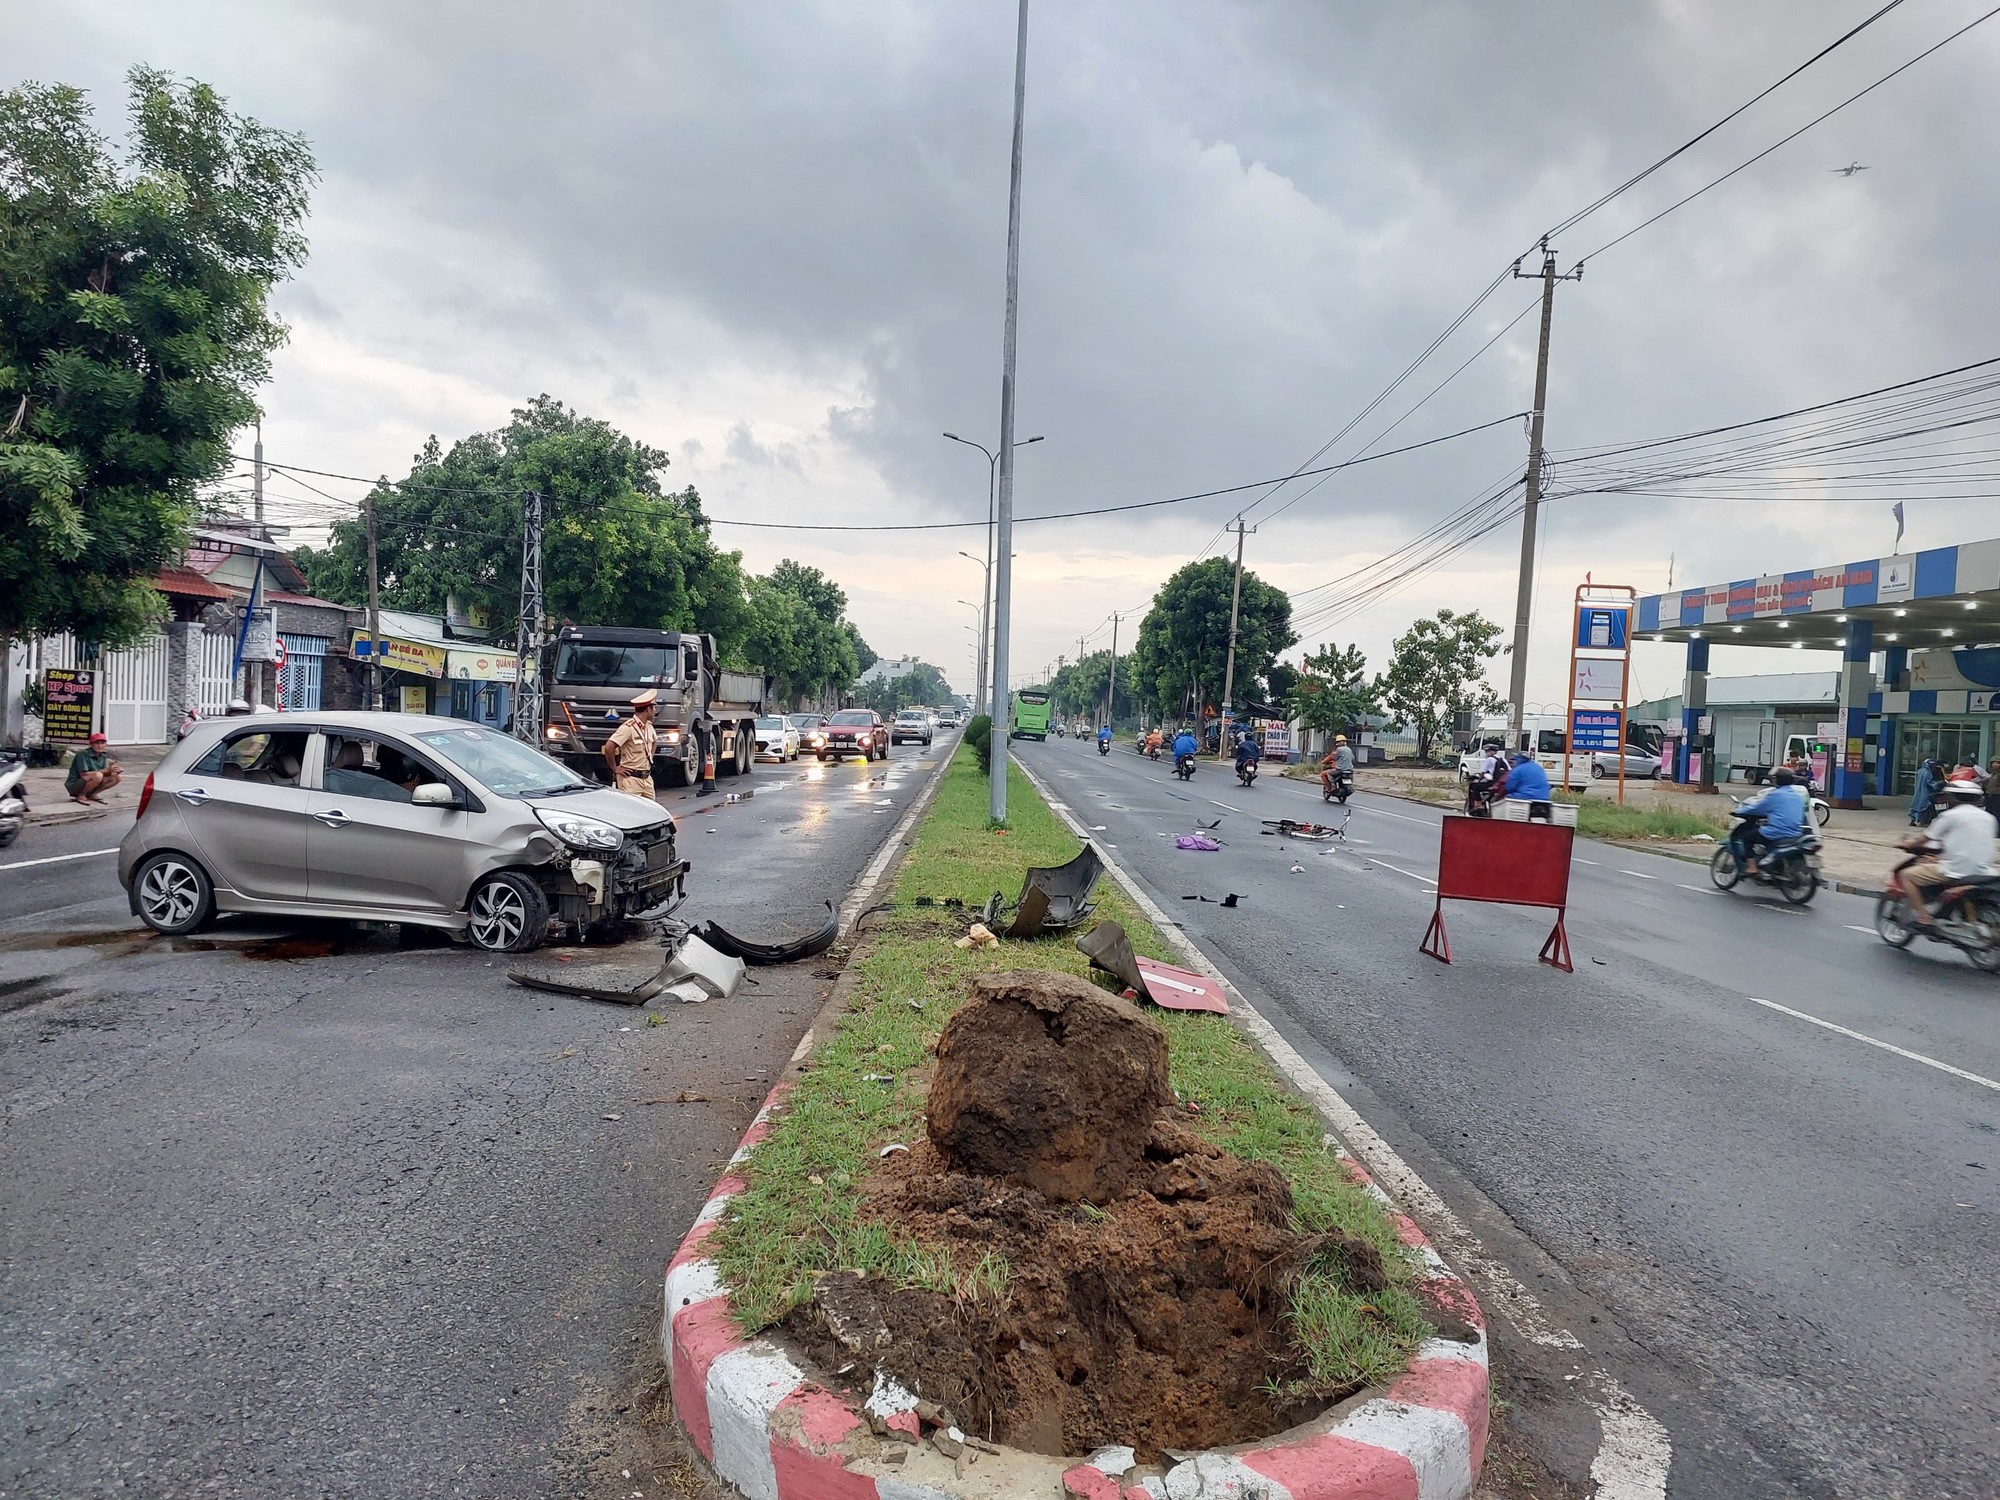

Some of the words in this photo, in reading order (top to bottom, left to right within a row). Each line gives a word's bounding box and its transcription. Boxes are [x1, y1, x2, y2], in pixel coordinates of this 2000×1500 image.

[1773, 584, 1779, 596] &
[399, 644, 411, 655] BÉ
[412, 648, 423, 657] BA
[496, 658, 511, 669] QUÁN
[49, 671, 75, 681] Shop
[47, 681, 63, 691] HP
[64, 683, 93, 693] Sport
[1267, 730, 1281, 739] CHÁO
